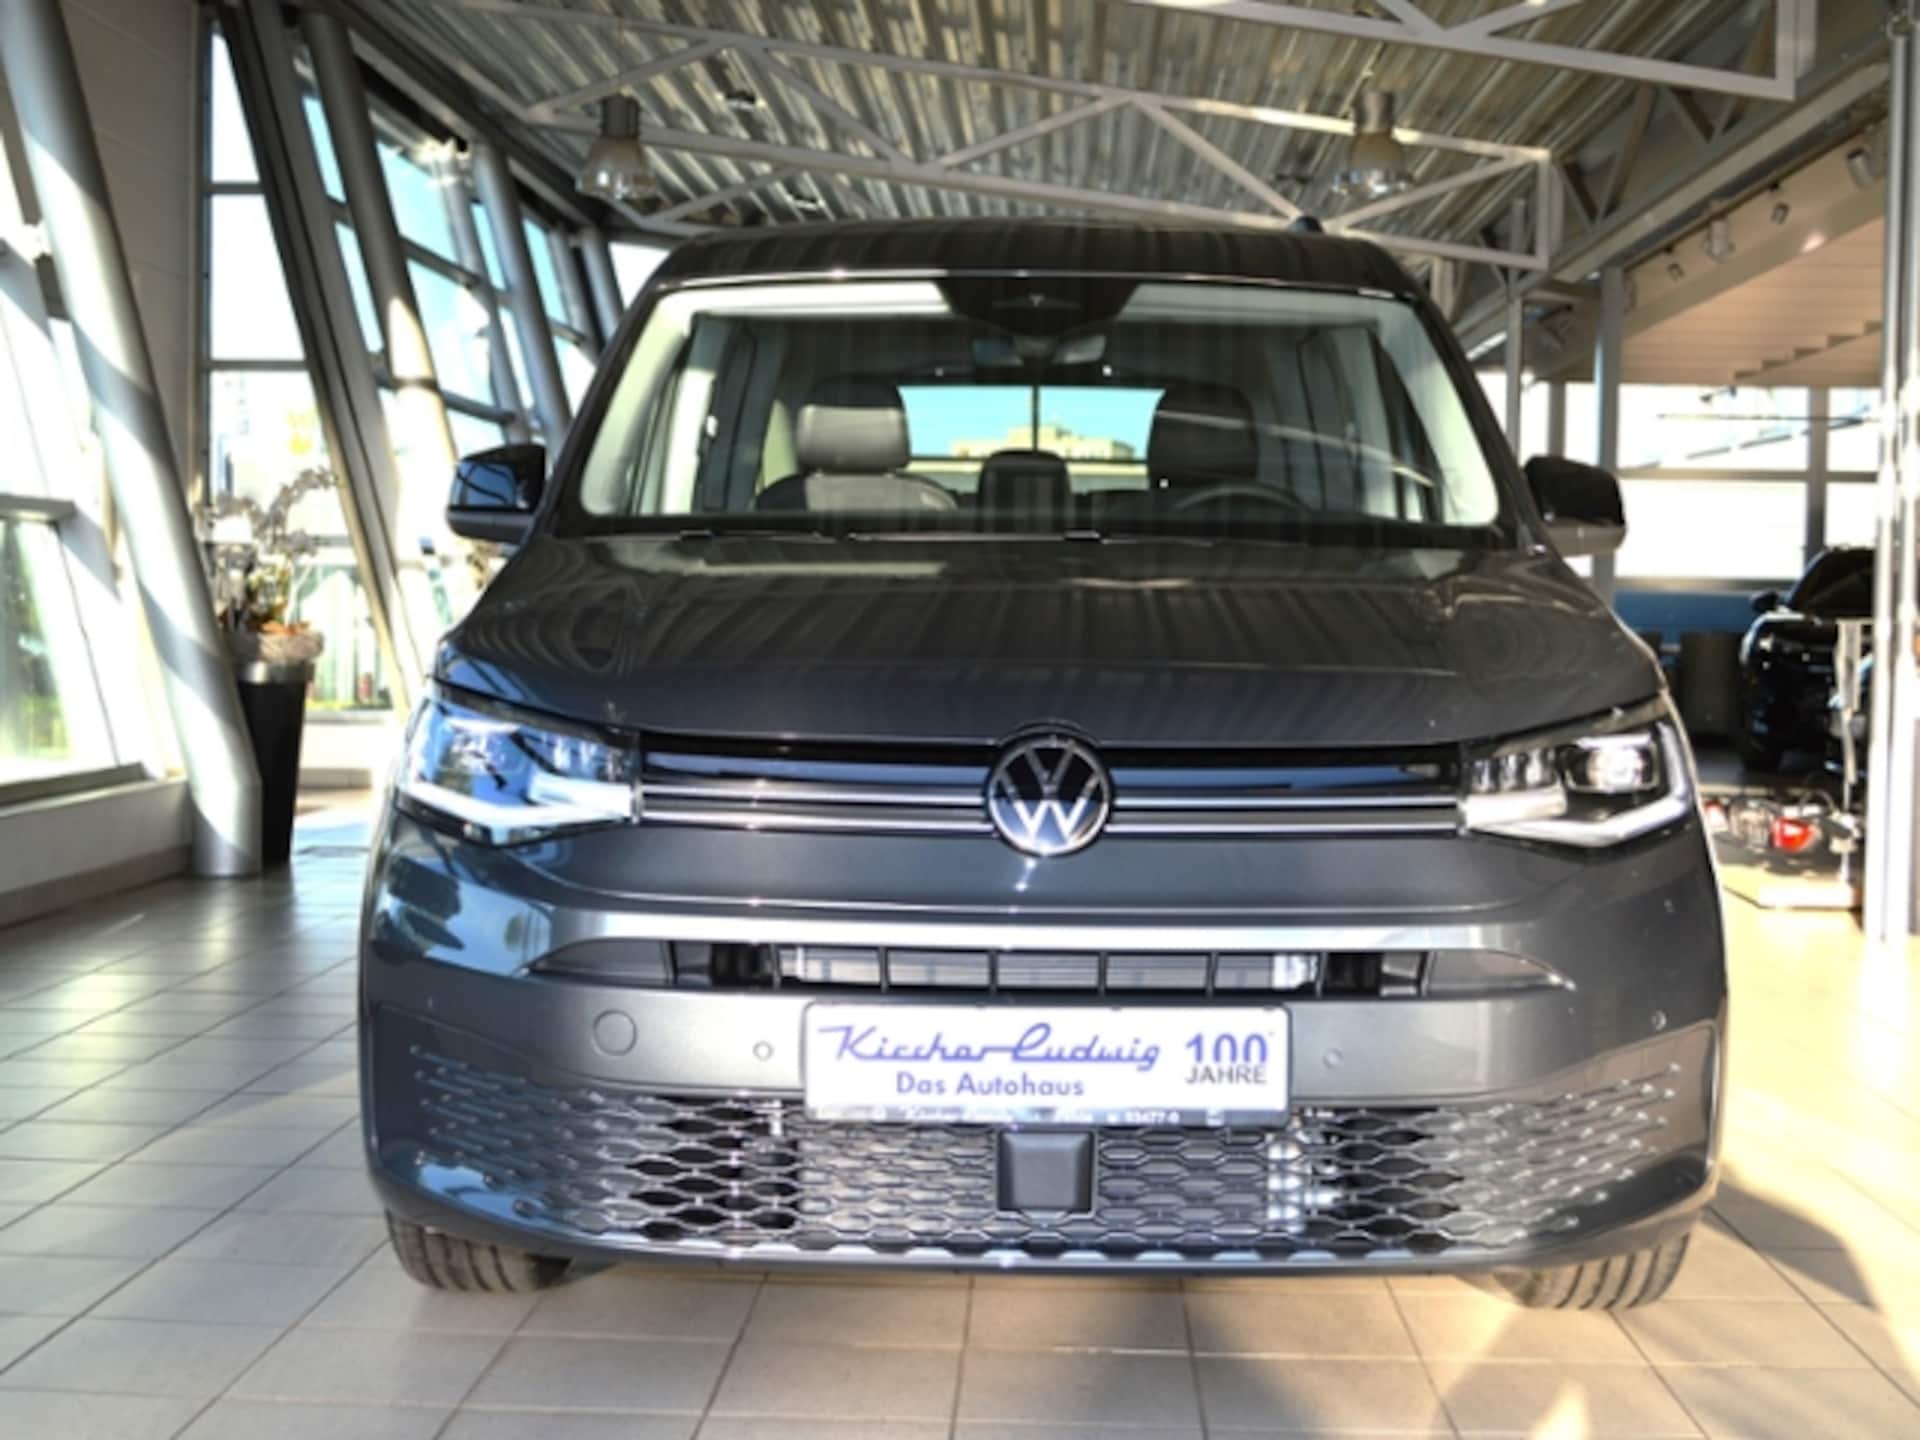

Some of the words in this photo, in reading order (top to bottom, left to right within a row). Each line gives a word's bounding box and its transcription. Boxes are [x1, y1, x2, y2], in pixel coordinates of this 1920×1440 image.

[1010, 1022, 1160, 1071] Ludwig
[1185, 1033, 1269, 1063] 100
[896, 1071, 946, 1095] Das
[955, 1072, 1084, 1097] Autohaus
[1184, 1064, 1267, 1084] JAHRE
